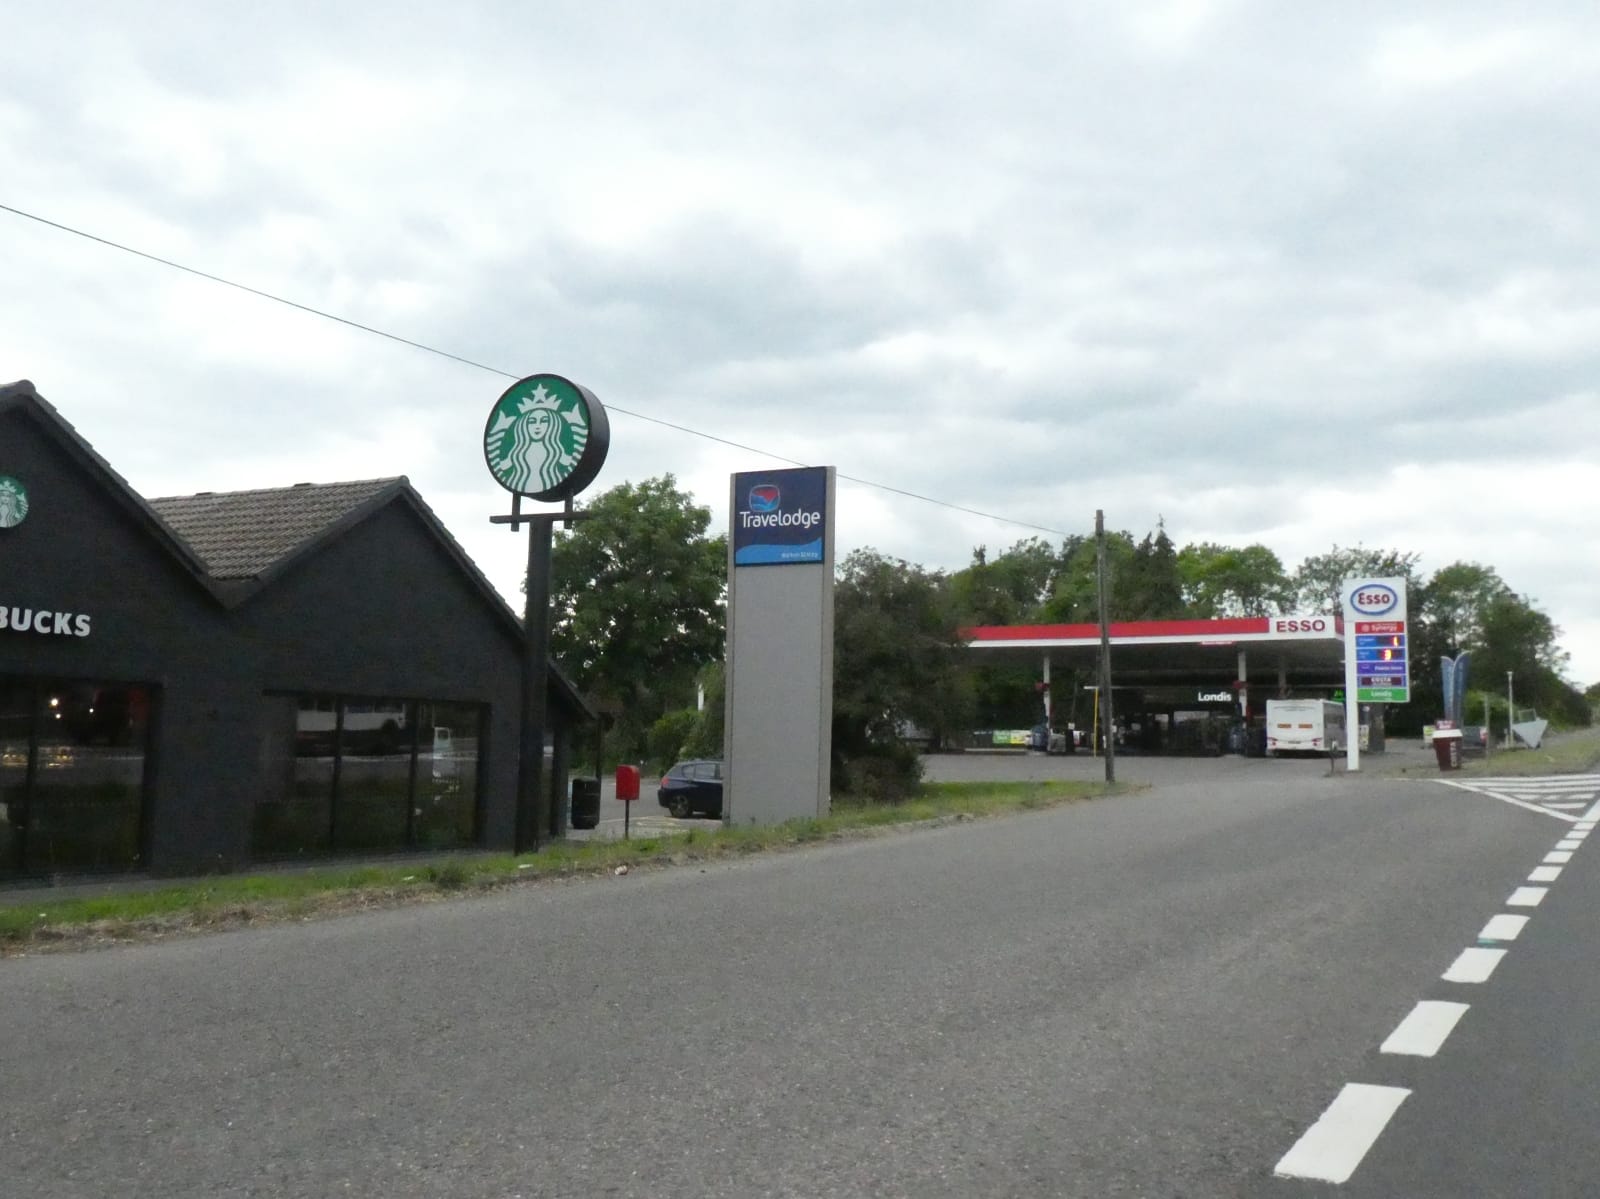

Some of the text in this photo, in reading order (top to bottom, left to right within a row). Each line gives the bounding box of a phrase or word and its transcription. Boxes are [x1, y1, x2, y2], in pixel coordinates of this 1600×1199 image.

[739, 508, 820, 529] Travelodge
[1357, 592, 1390, 605] Esso
[1276, 619, 1326, 633] ESSO
[1197, 691, 1232, 702] Londis
